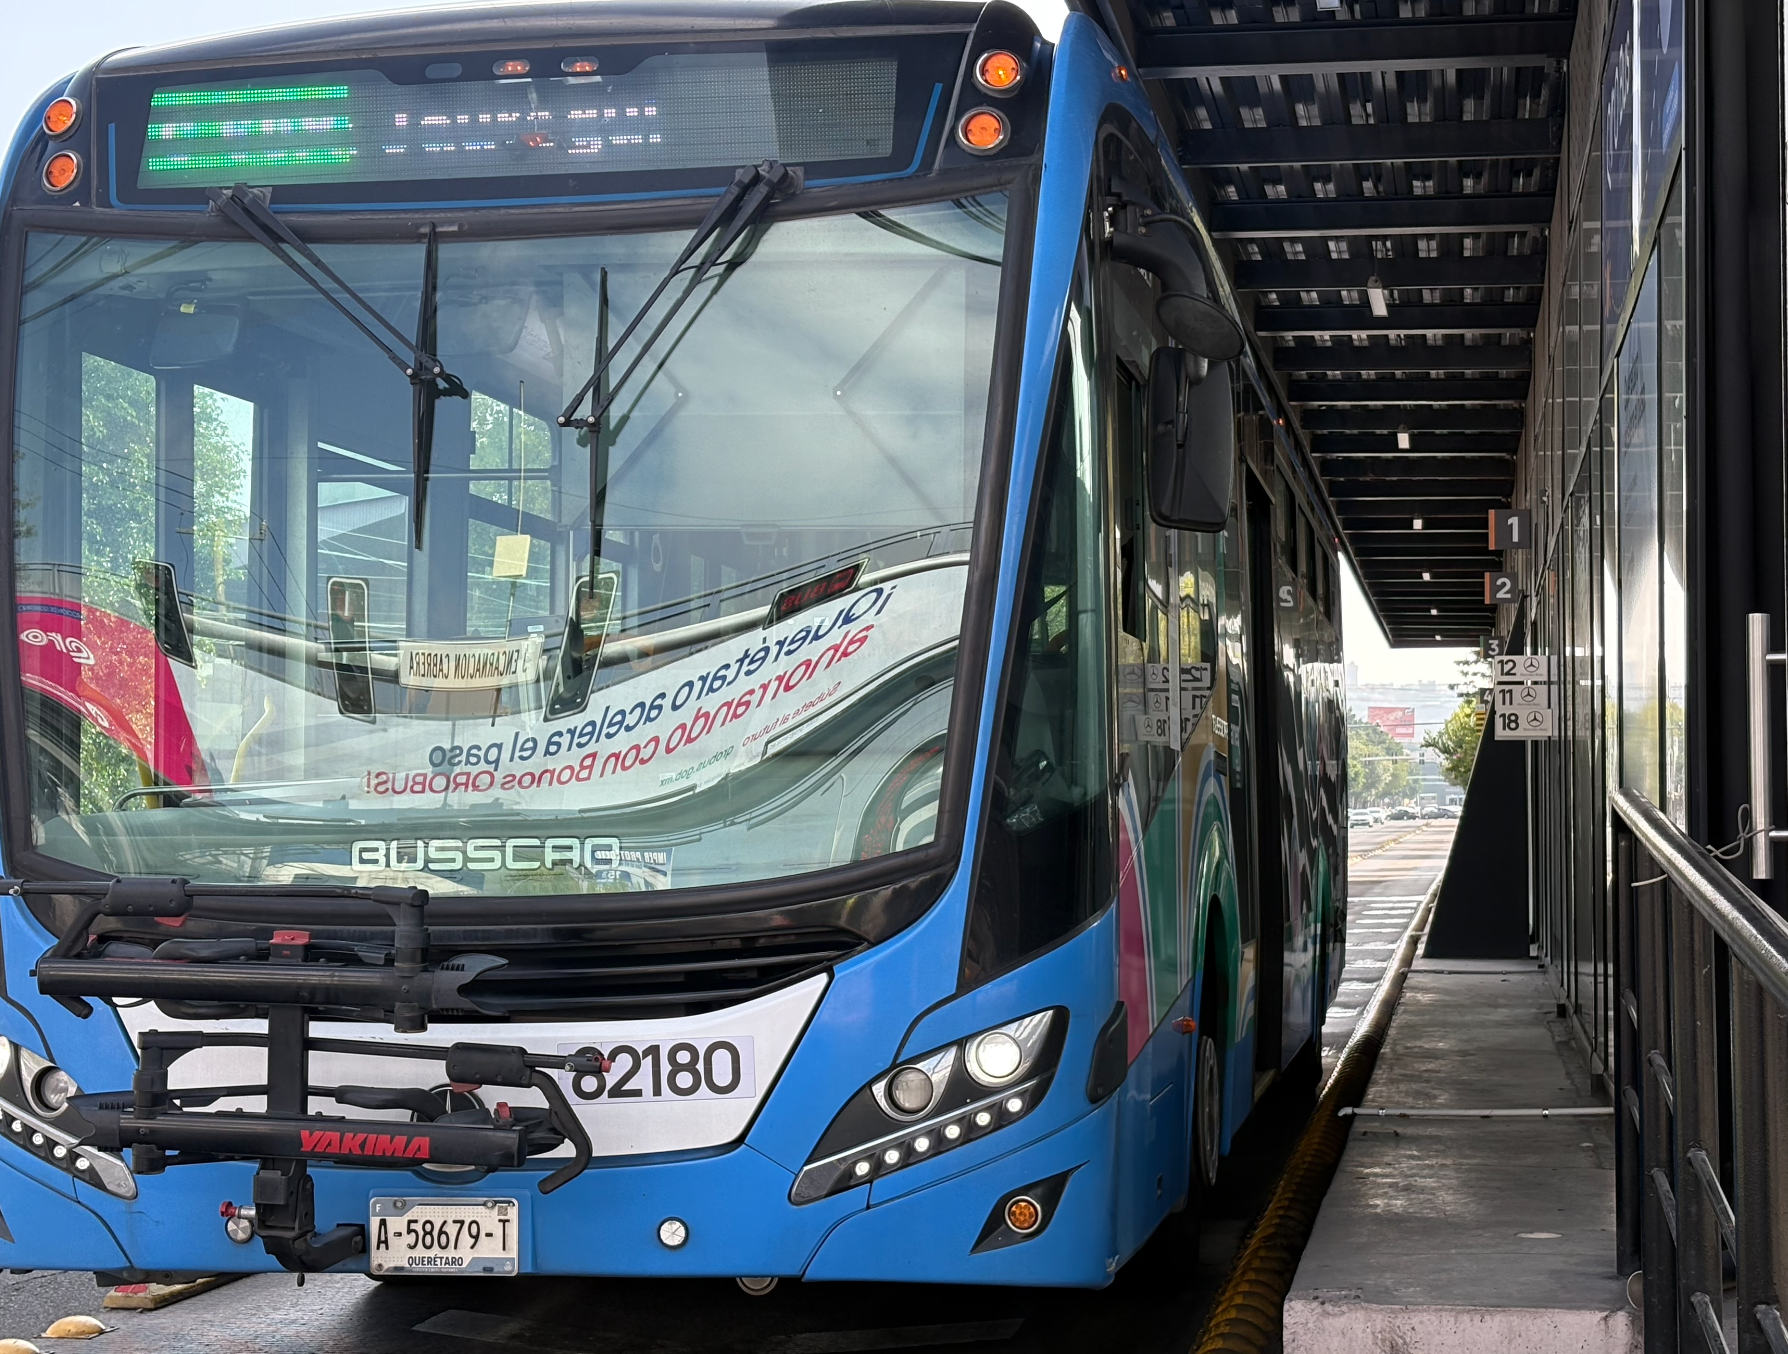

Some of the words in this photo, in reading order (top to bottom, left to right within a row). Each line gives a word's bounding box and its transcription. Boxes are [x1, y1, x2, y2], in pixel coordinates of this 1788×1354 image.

[1507, 517, 1518, 542] 1
[1496, 578, 1511, 598] 2
[1488, 639, 1499, 656] 3
[1497, 659, 1517, 677] 12
[1483, 691, 1491, 702] 4
[1499, 688, 1513, 706] 11
[1499, 712, 1520, 731] 18
[571, 1040, 742, 1100] 82180
[300, 1129, 430, 1159] YAKIMA
[375, 1203, 381, 1213] F
[376, 1218, 511, 1251] A-58679-T
[407, 1254, 464, 1267] QUERÉTARO
